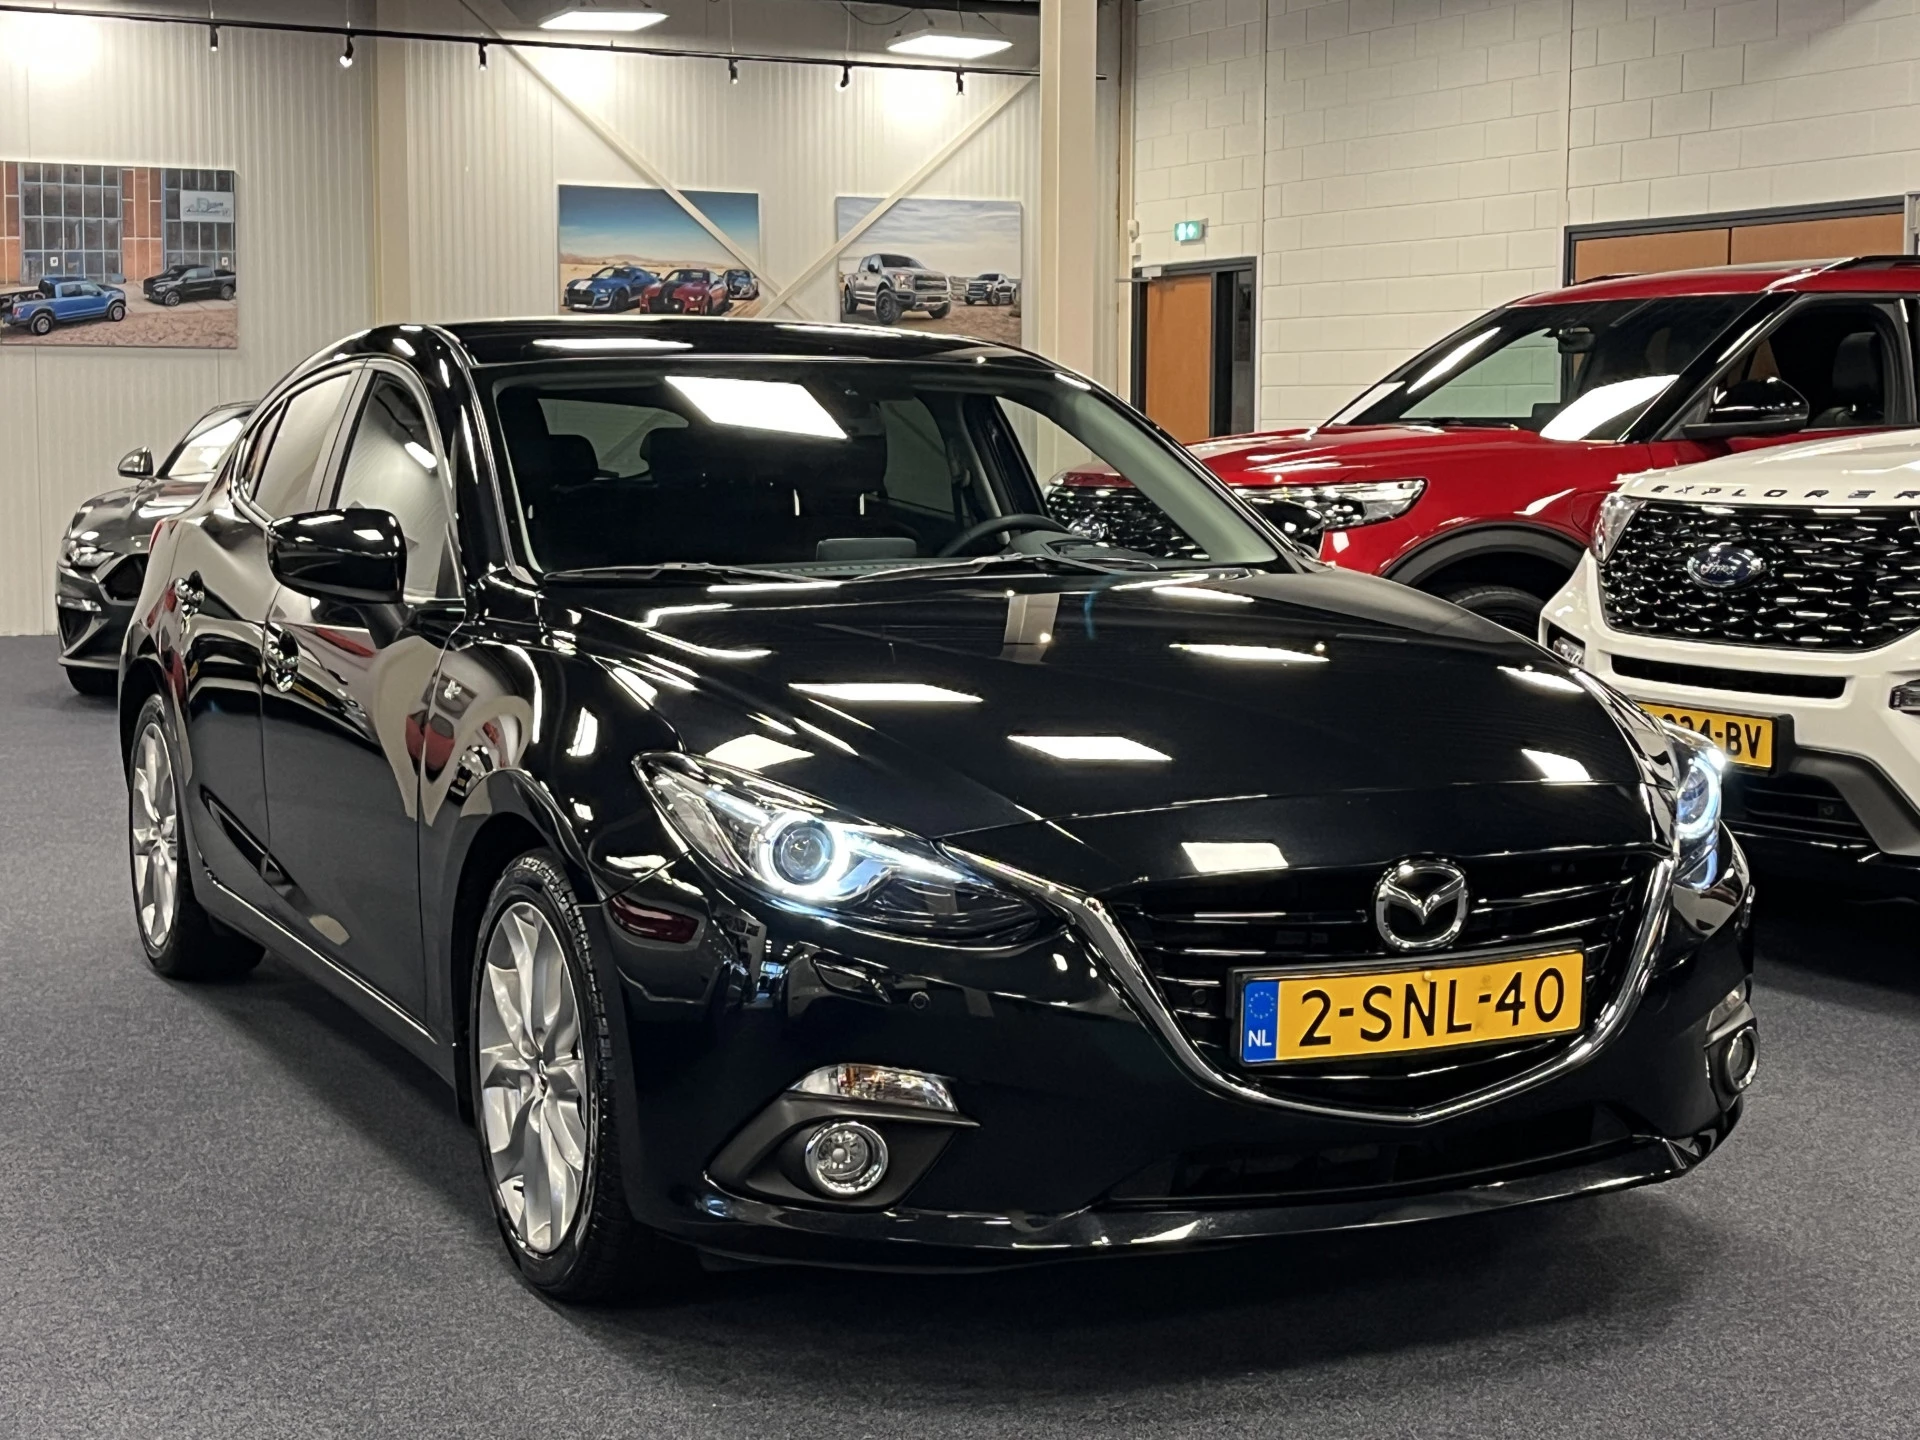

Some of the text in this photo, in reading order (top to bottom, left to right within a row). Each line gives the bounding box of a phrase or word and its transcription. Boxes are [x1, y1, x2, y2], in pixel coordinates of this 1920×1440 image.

[1651, 485, 1920, 499] EXPLORER
[1299, 967, 1564, 1047] 2-SNL-40
[1248, 1029, 1272, 1047] NL
